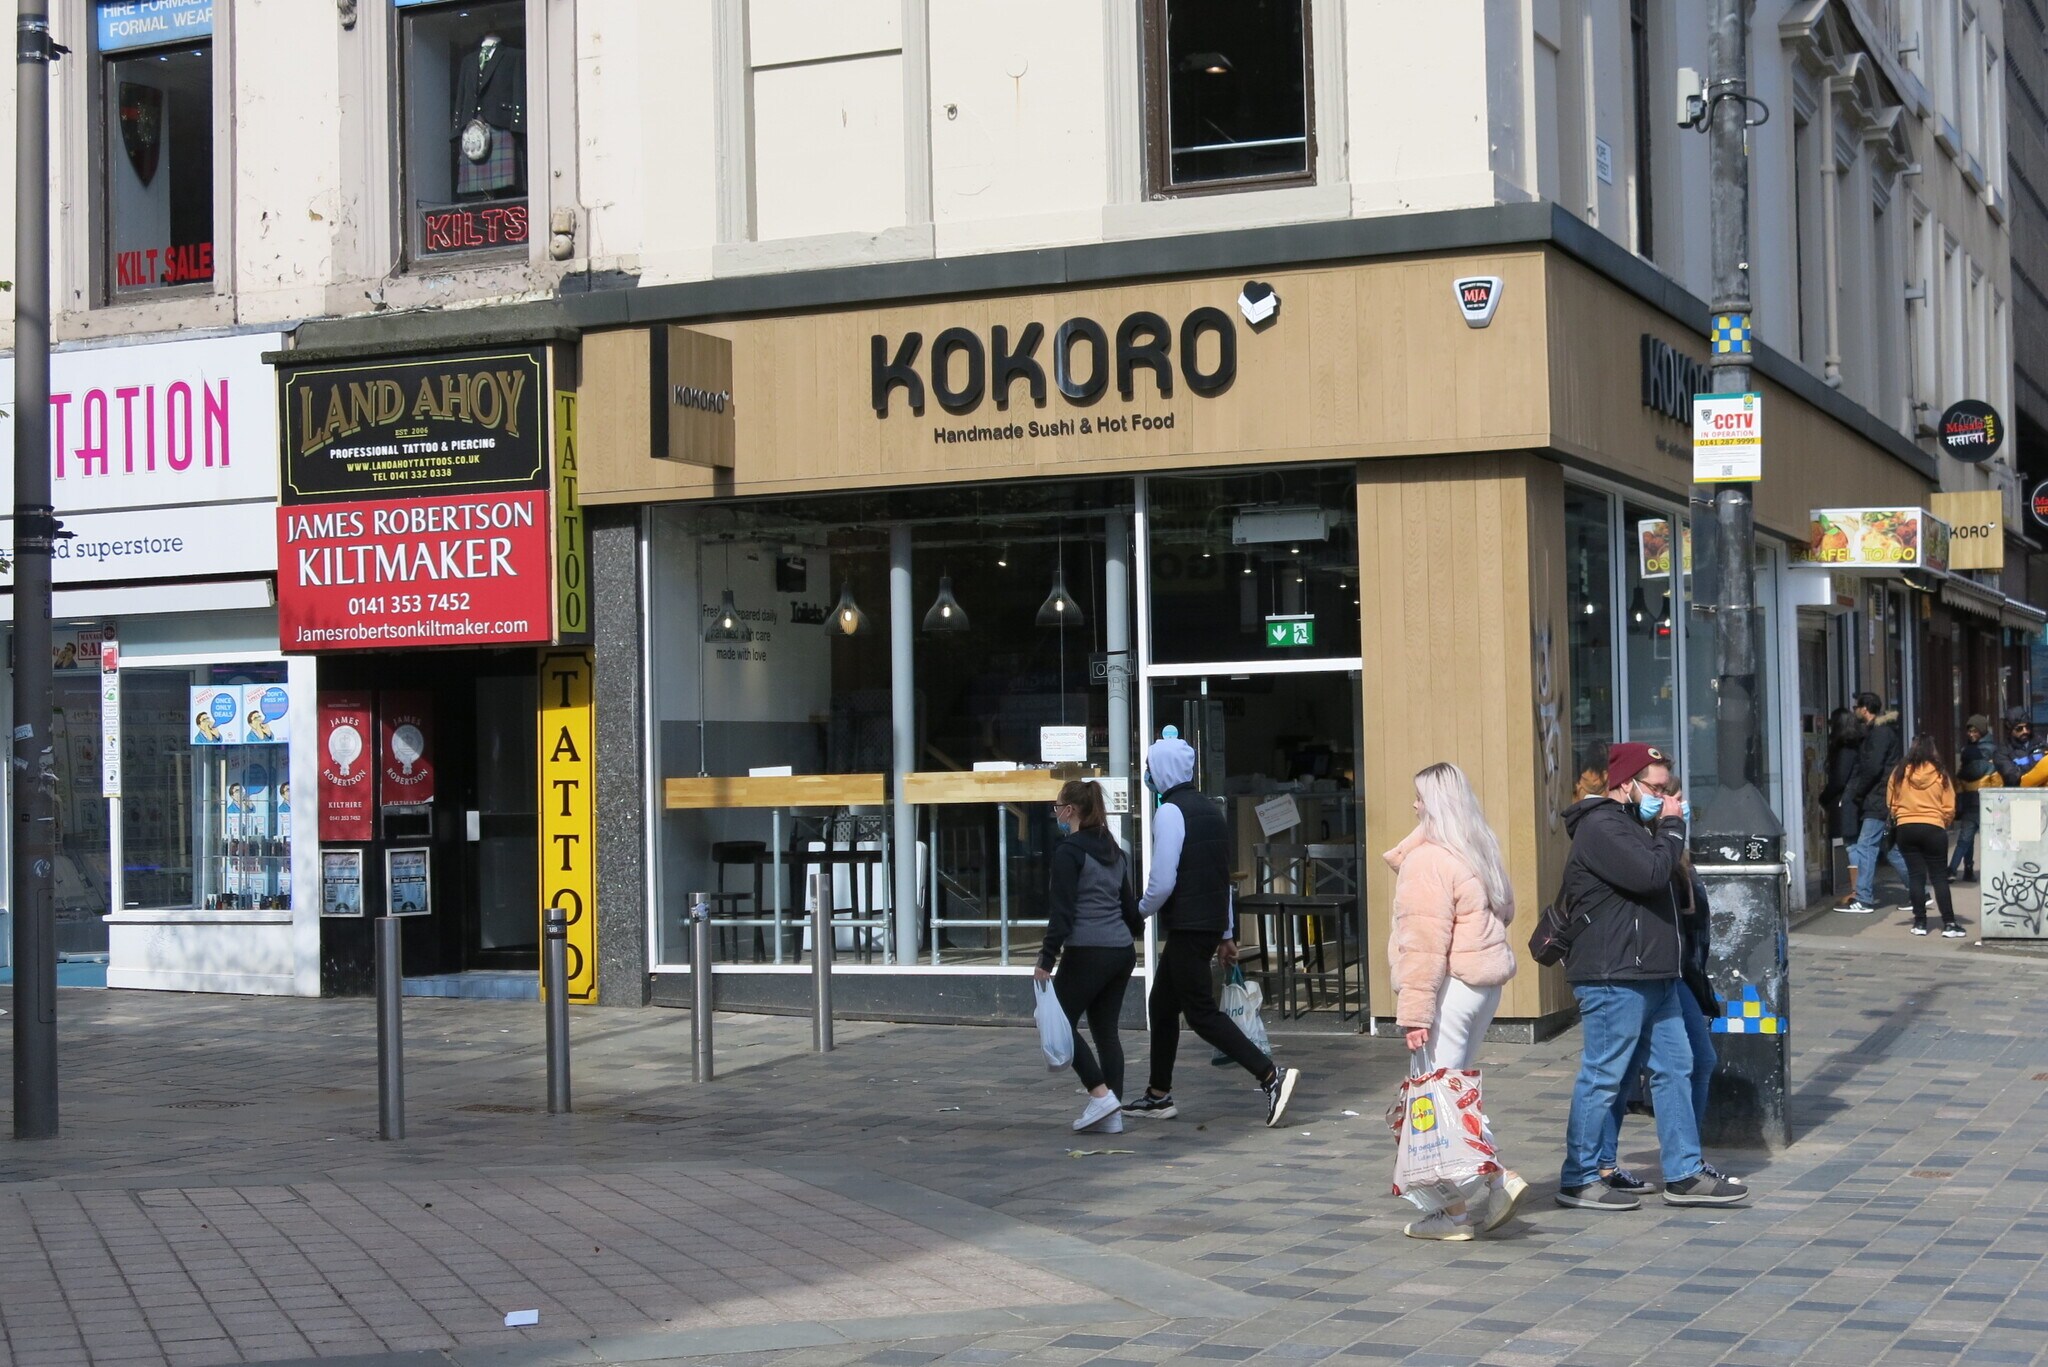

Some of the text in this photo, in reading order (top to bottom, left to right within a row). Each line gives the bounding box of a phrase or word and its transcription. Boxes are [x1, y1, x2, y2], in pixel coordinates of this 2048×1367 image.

[110, 16, 168, 37] FORMAL
[425, 206, 528, 251] KILTS
[117, 242, 214, 286] KILT SALE
[871, 306, 1237, 414] KOKORO
[673, 385, 725, 413] KOKORO
[300, 370, 525, 456] LAND AHOY
[1714, 413, 1753, 429] CCTV
[395, 428, 409, 436] EST
[934, 412, 1175, 443] Handmade Sushi & Hot Food
[1711, 430, 1754, 438] OPERATION
[330, 438, 495, 459] PROFESSIONAL TATTOO & PIERCING
[346, 454, 480, 472] WWW.LANDAHOYTATTOOS.CO.UK
[372, 468, 452, 481] TEL 0141 332 0338
[286, 501, 534, 543] JAMES ROBERTSON
[561, 395, 581, 628] TATTOO
[76, 535, 184, 562] superstore
[1862, 547, 1884, 561] TO
[1891, 547, 1915, 560] GO
[298, 537, 518, 587] KILTMAKER
[348, 592, 471, 615] 0141 353 7452
[296, 618, 528, 643] Jamesrobertsonkiltmaker.com
[716, 647, 767, 661] made with love
[330, 716, 359, 727] JAMES
[323, 768, 366, 787] ROBERTSON
[386, 767, 428, 785] ROBERTSON
